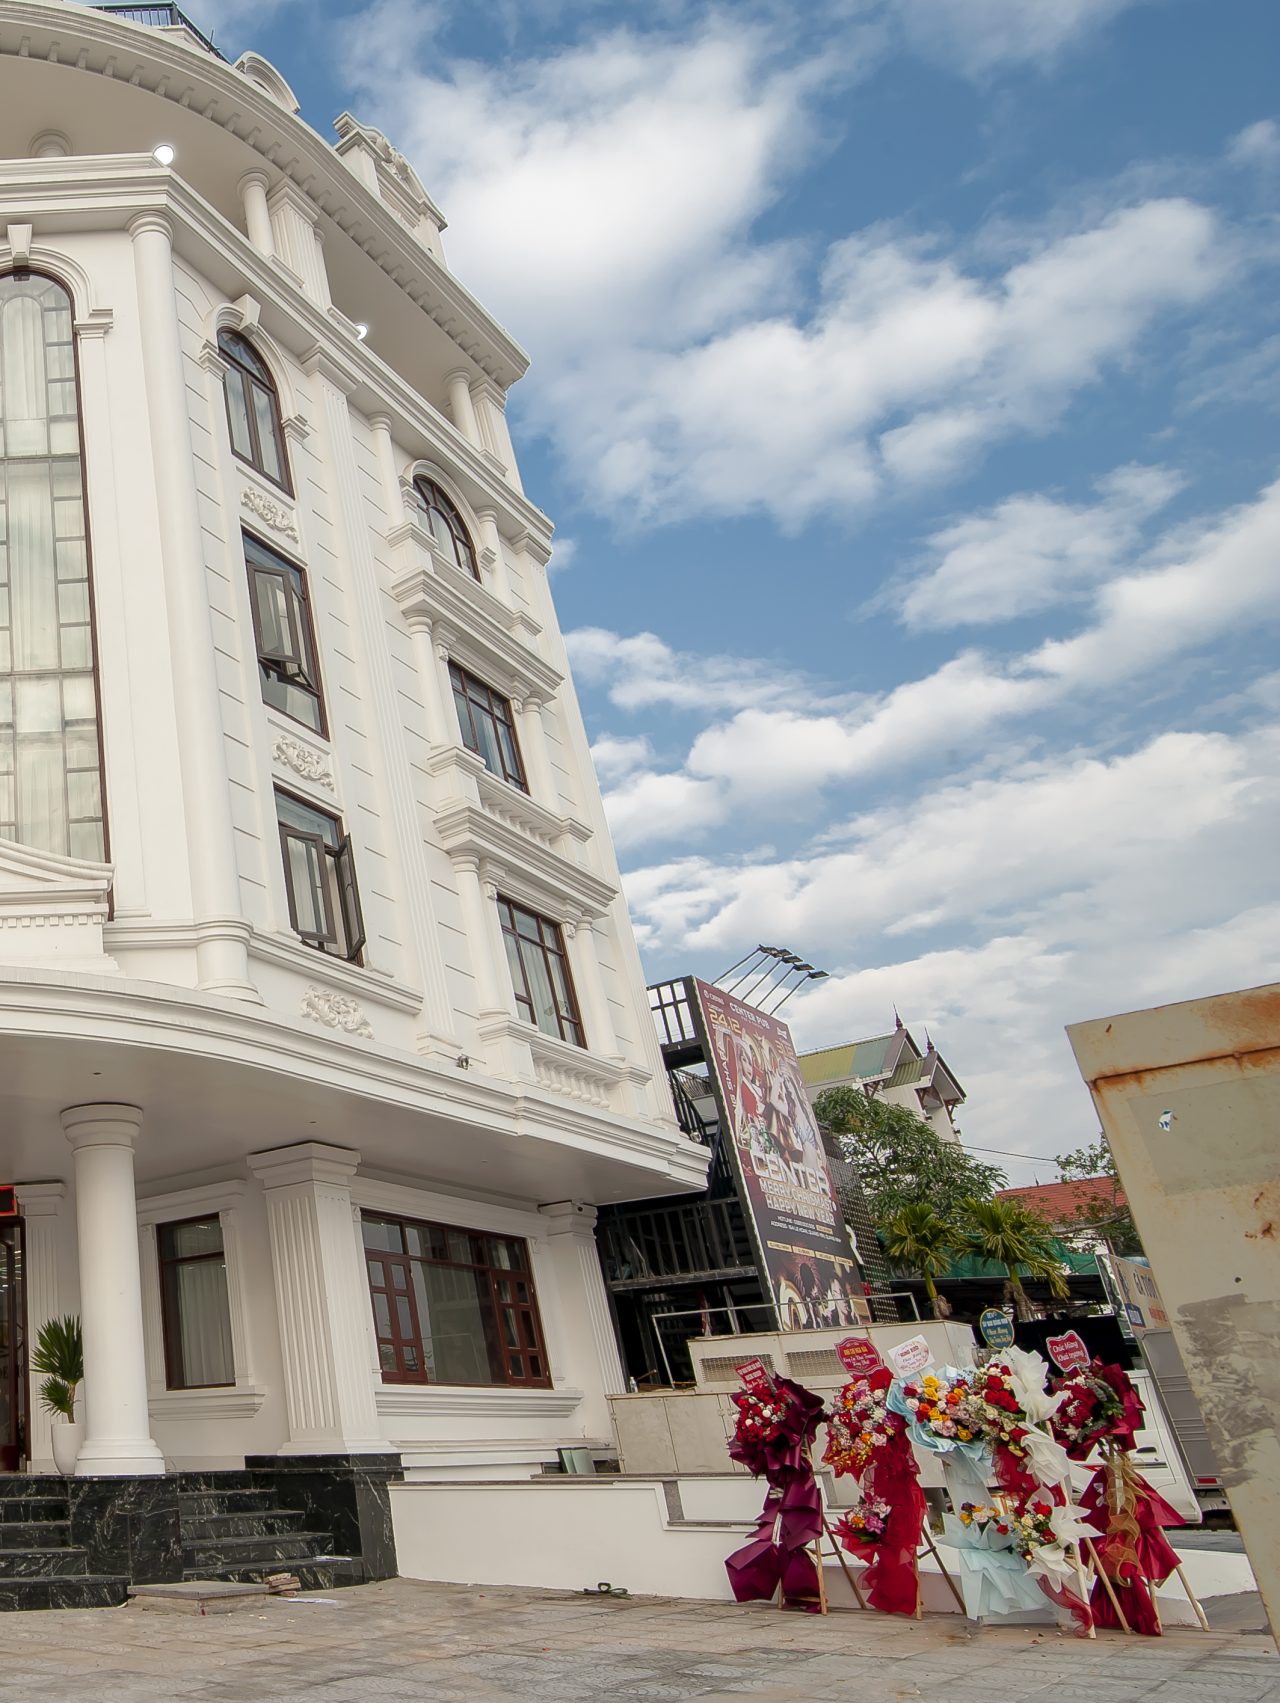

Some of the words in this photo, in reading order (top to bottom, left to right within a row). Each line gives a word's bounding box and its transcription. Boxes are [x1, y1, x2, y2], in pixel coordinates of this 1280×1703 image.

[708, 1007, 742, 1034] 24.12
[750, 1150, 833, 1199] CENTER
[765, 1193, 798, 1216] HAPPY
